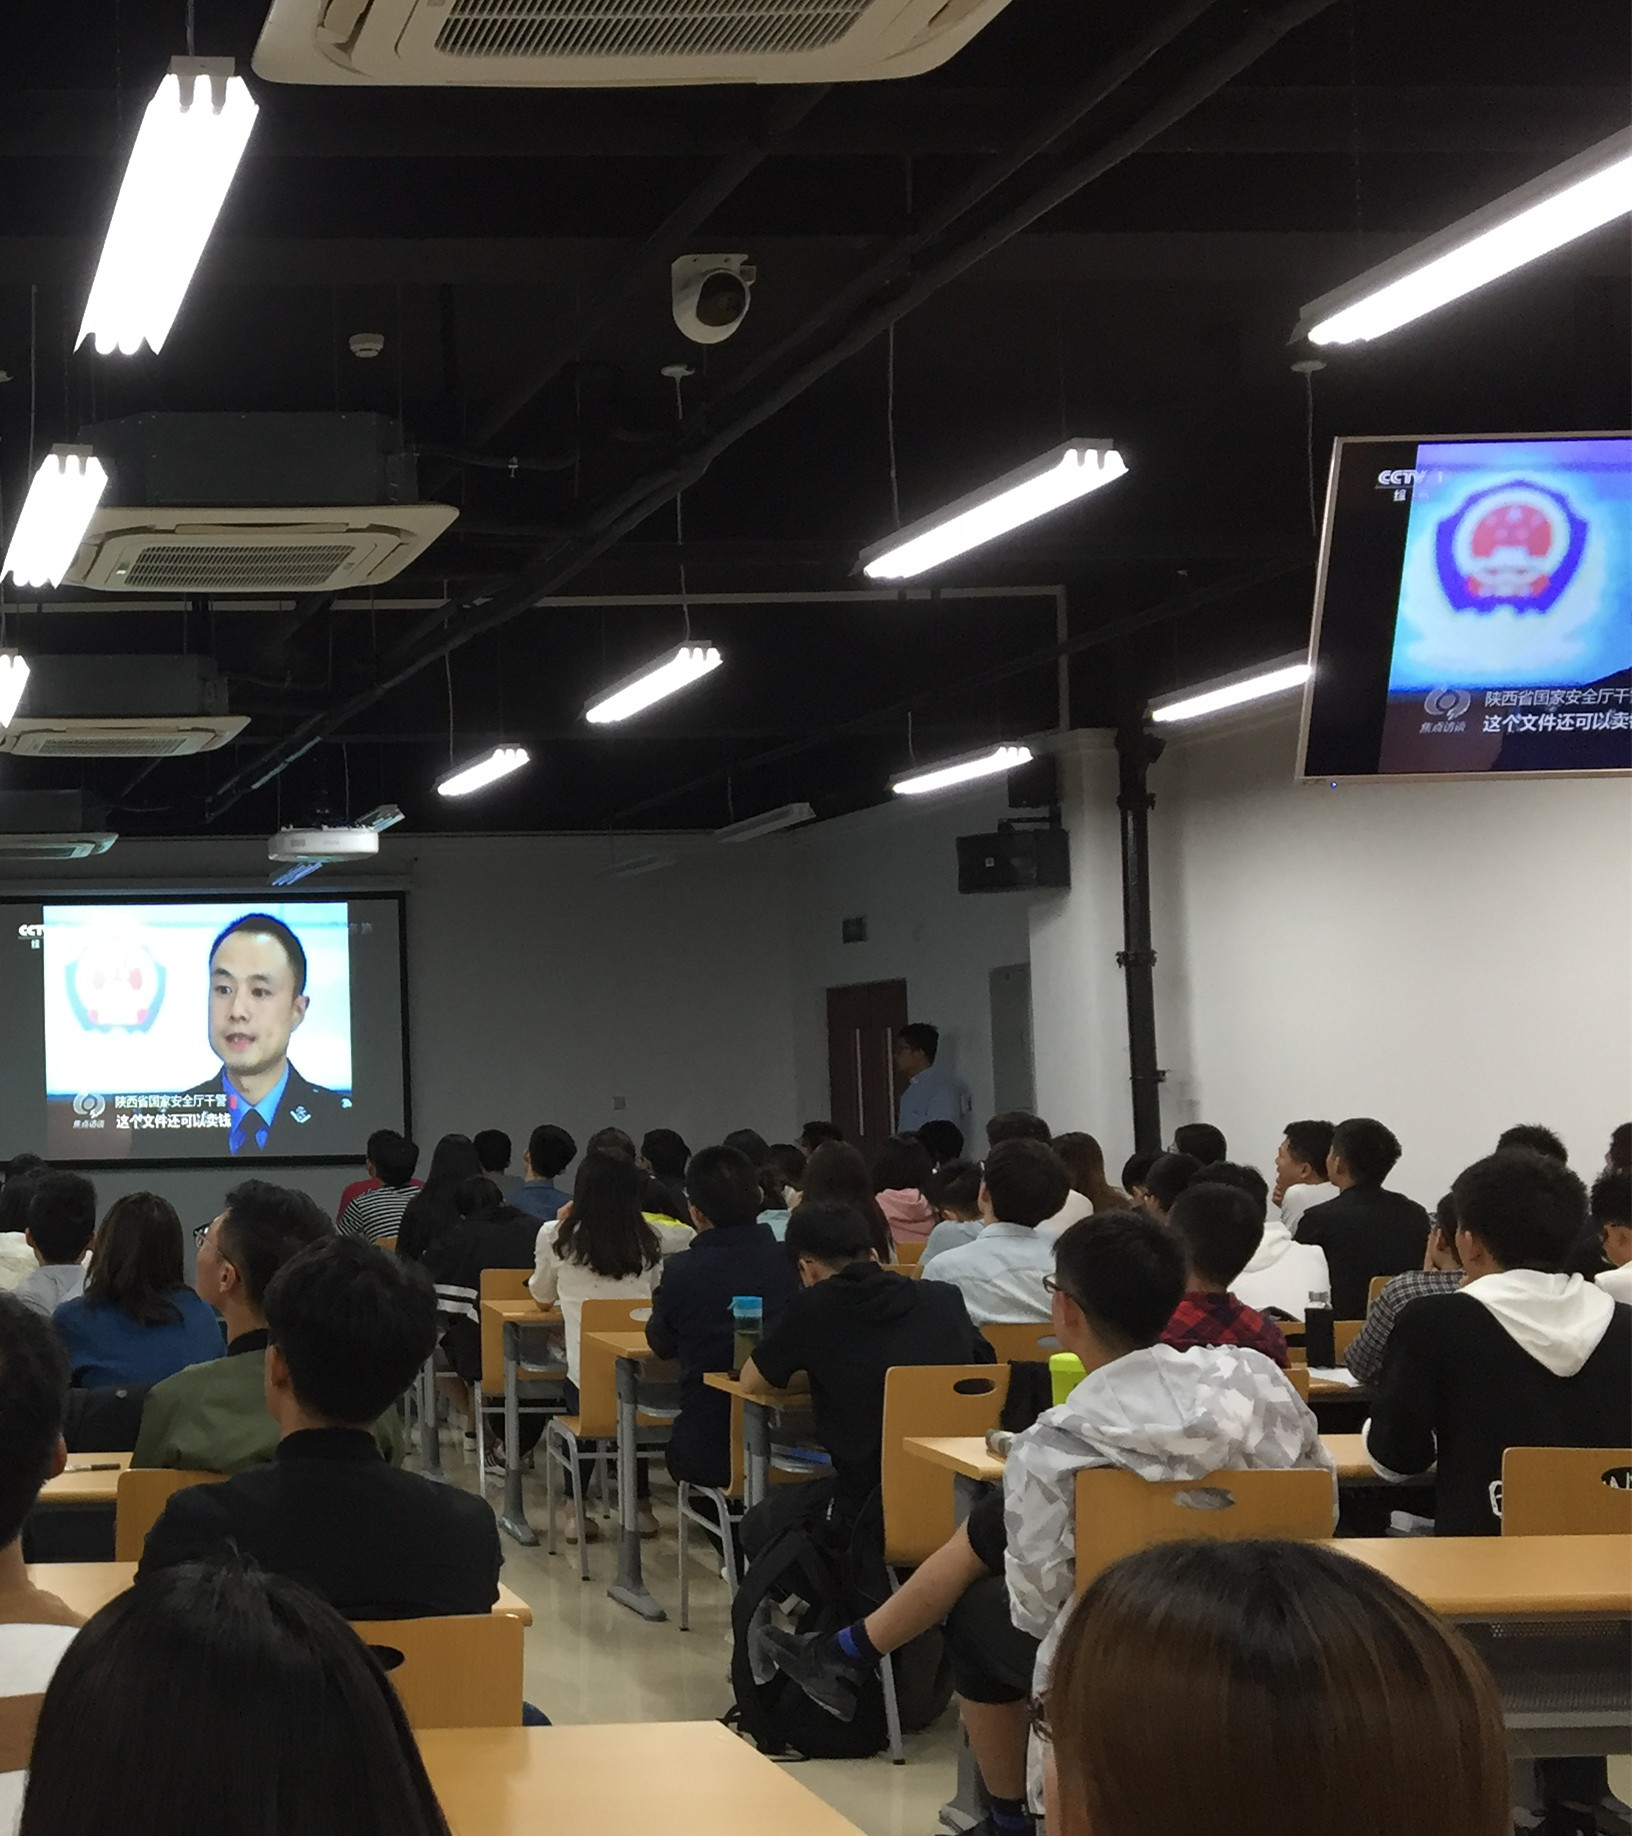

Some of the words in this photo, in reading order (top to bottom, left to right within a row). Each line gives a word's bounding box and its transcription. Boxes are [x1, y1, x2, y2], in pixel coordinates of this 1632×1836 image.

[1378, 469, 1427, 485] CCTV
[1484, 688, 1632, 708] 陕西省国家安全厅干
[1482, 711, 1632, 733] 这个文件还可以卖
[114, 1094, 227, 1109] 陕西省国家安全厅干警
[116, 1112, 232, 1129] 这个文件还可以卖钱
